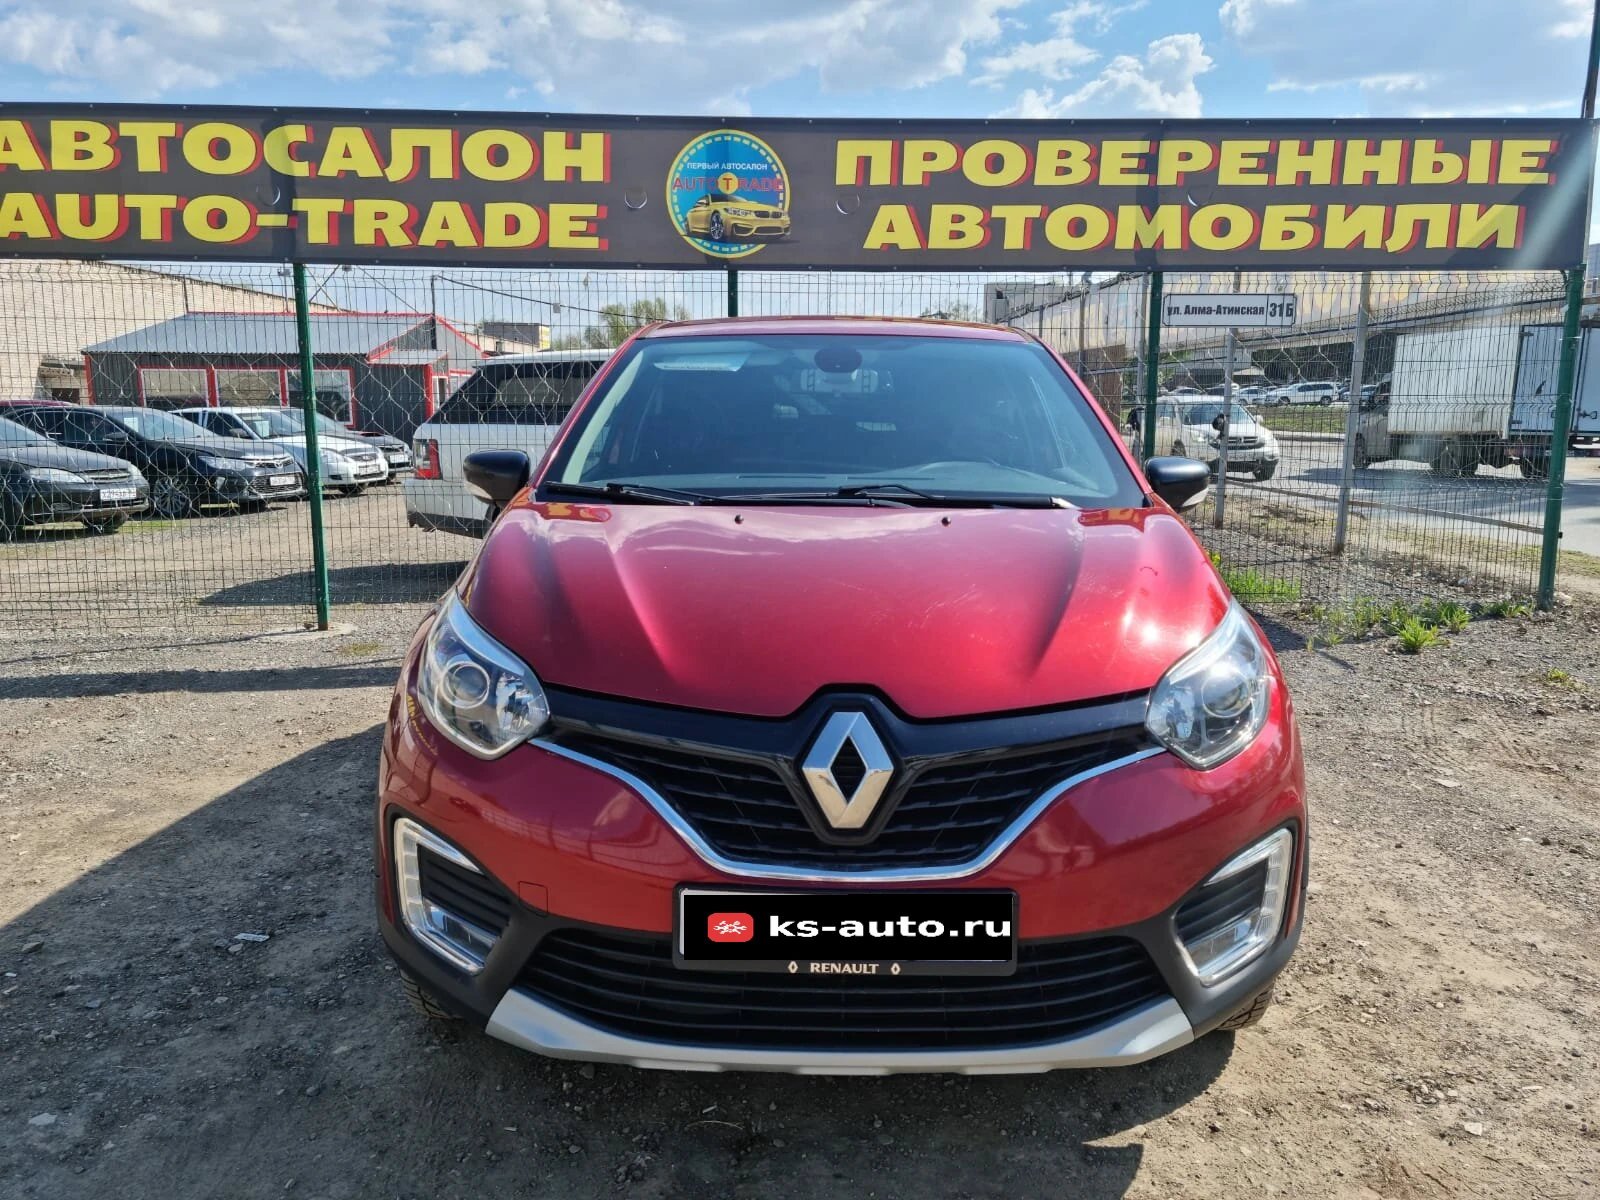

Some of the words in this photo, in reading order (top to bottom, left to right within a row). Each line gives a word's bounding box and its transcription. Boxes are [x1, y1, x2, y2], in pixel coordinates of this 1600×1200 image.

[0, 120, 610, 182] АВТОСАЛОН
[687, 162, 719, 170] ПЕРВЫЙ
[721, 162, 768, 170] АВТОСАЛОН
[835, 139, 1558, 187] ПРОВЕРЕННЫЕ
[0, 192, 608, 250] AUTO-TRADE
[863, 203, 1525, 253] АВТОМОБИЛИ
[1167, 305, 1181, 316] ул.
[1184, 304, 1265, 316] Алма-Атинская
[1269, 302, 1294, 318] 31Б
[810, 962, 879, 974] RENAULT
